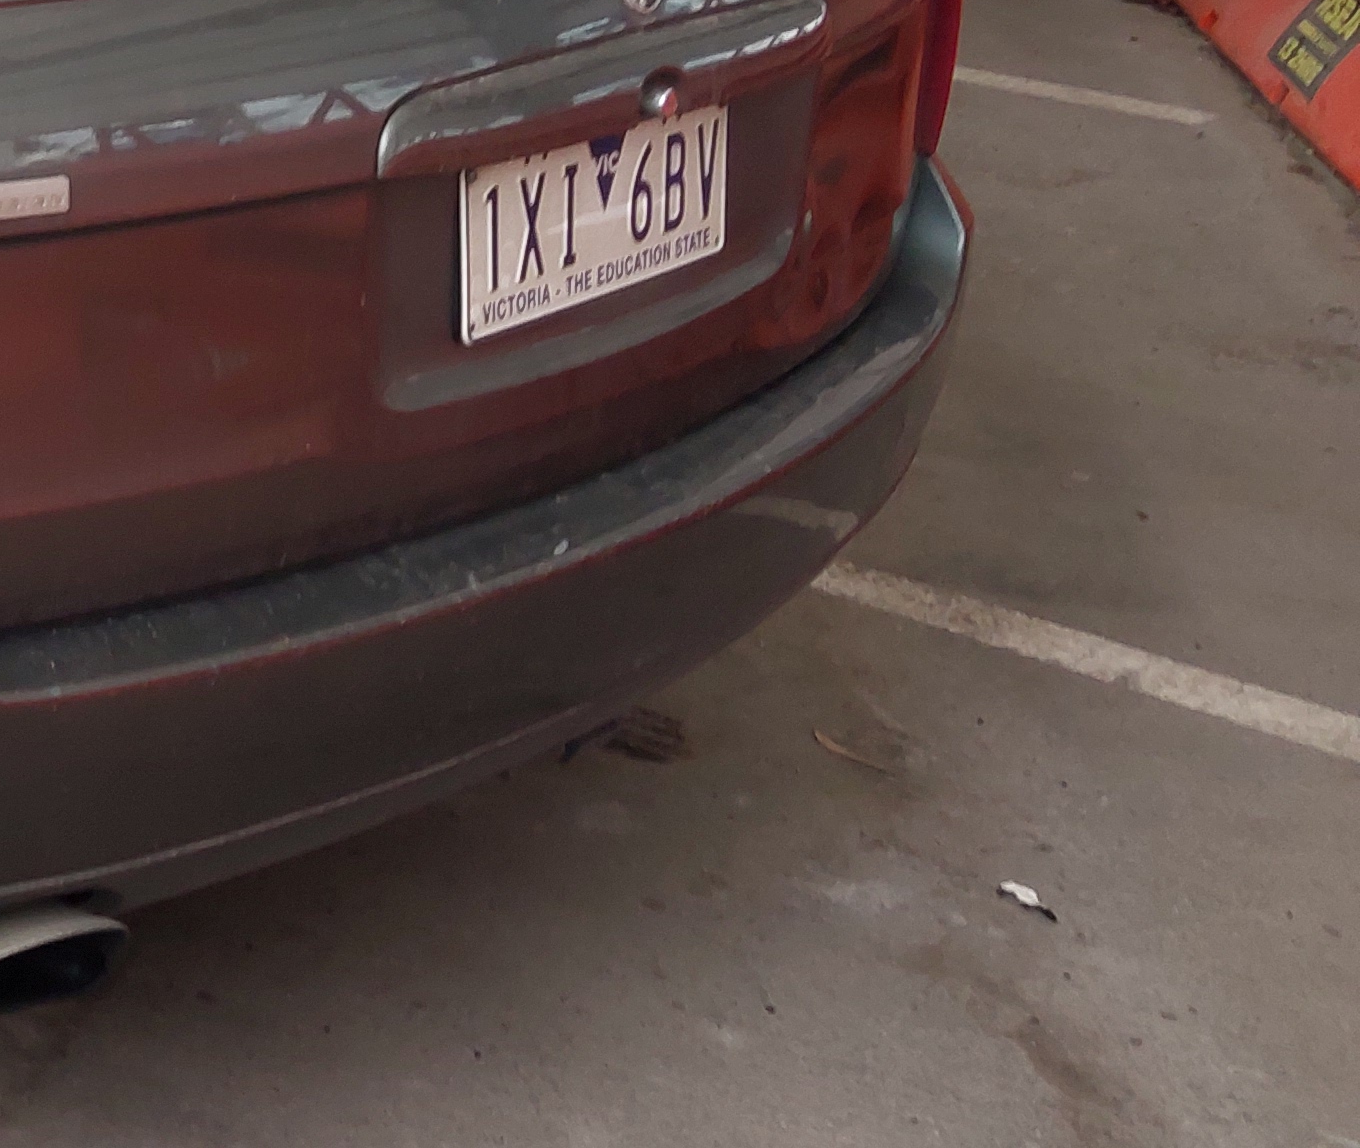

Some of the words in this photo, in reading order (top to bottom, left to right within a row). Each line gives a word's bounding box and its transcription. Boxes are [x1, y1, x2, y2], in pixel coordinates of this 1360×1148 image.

[593, 149, 620, 177] VIC
[630, 117, 720, 242] 6BV
[482, 284, 551, 325] VICTORIA
[566, 269, 593, 296] THE
[596, 243, 671, 287] EDUCATION
[675, 226, 711, 260] STATE
